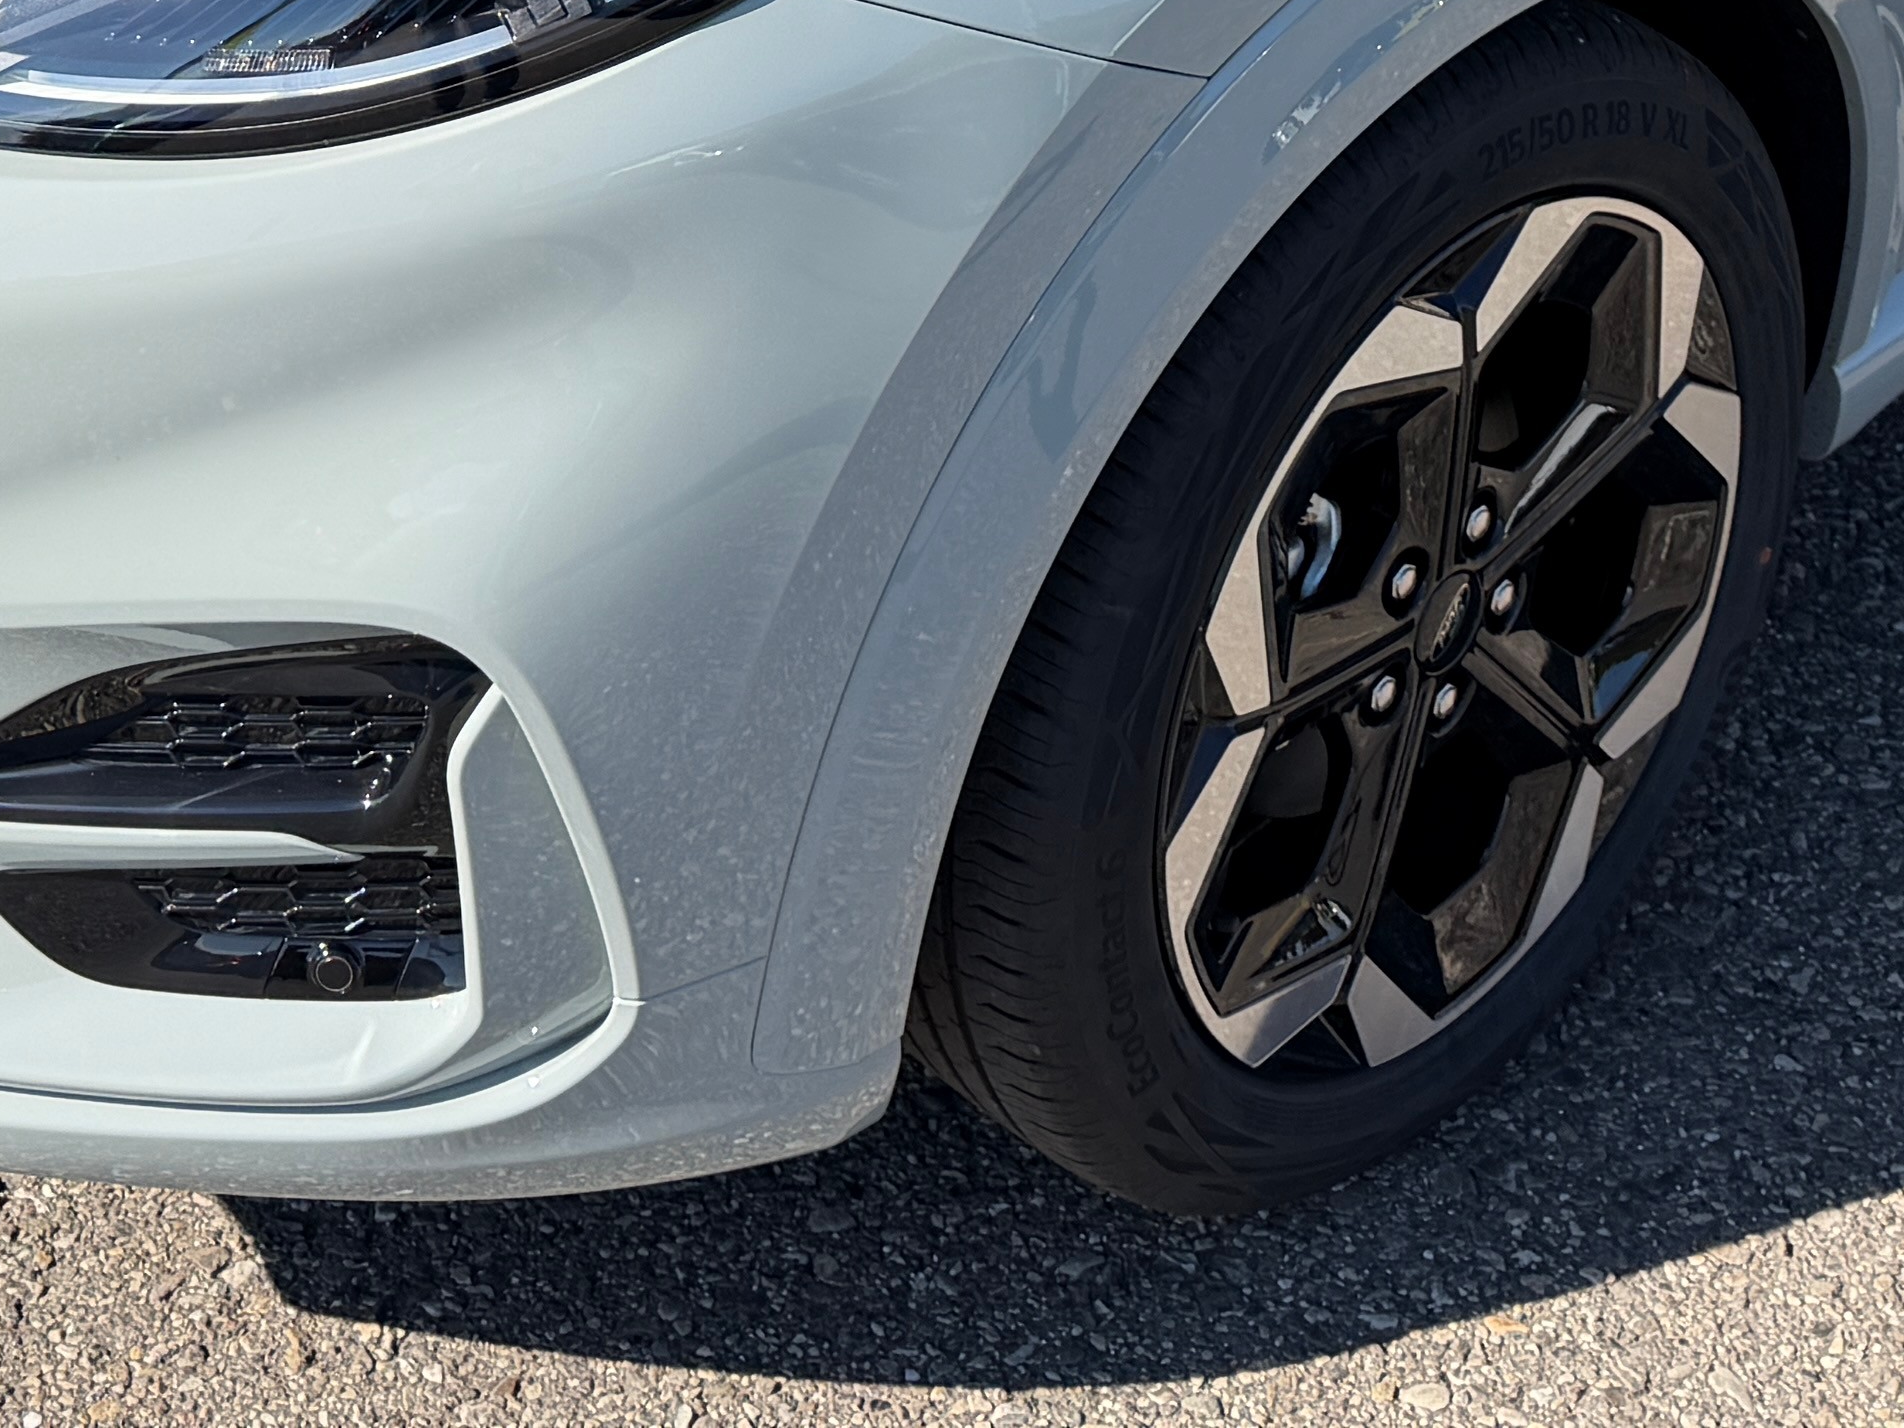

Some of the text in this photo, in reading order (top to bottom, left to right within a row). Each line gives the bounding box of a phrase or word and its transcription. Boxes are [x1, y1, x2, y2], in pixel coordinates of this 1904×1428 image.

[1477, 99, 1689, 184] 215/50 R 18 V XL
